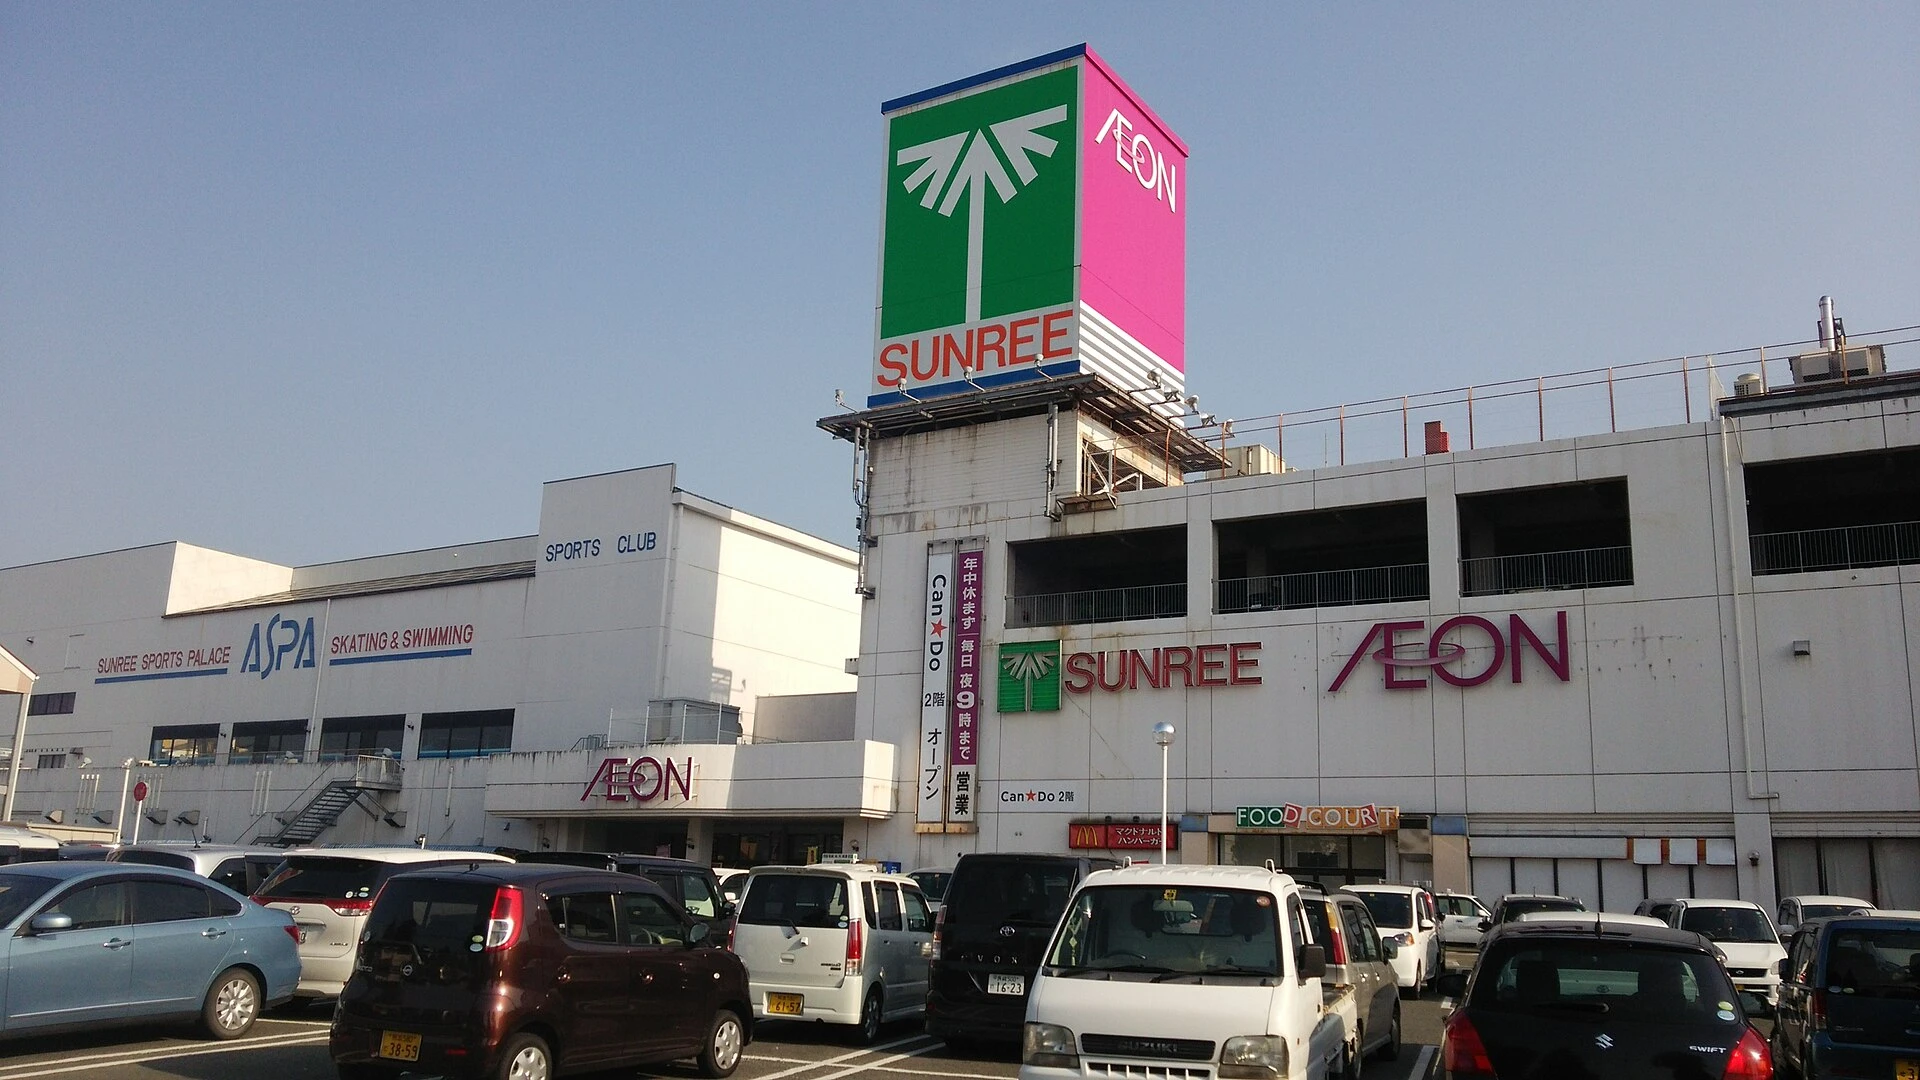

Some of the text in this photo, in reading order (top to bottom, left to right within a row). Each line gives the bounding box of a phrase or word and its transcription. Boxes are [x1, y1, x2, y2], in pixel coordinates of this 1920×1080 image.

[876, 308, 1074, 387] SUNREE
[545, 531, 657, 562] SPORTS CLUB
[240, 612, 316, 680] ASPA
[330, 623, 474, 654] SKATING & SWIMMING
[97, 646, 232, 674] SUNREE SPORTS PALACE
[1064, 641, 1264, 694] SUNREE
[925, 727, 942, 800] オープン
[954, 770, 971, 816] 営業
[1237, 803, 1395, 828] FOOD COURT
[1117, 837, 1163, 845] ハンバーガ
[1689, 1045, 1727, 1054] SWIFT
